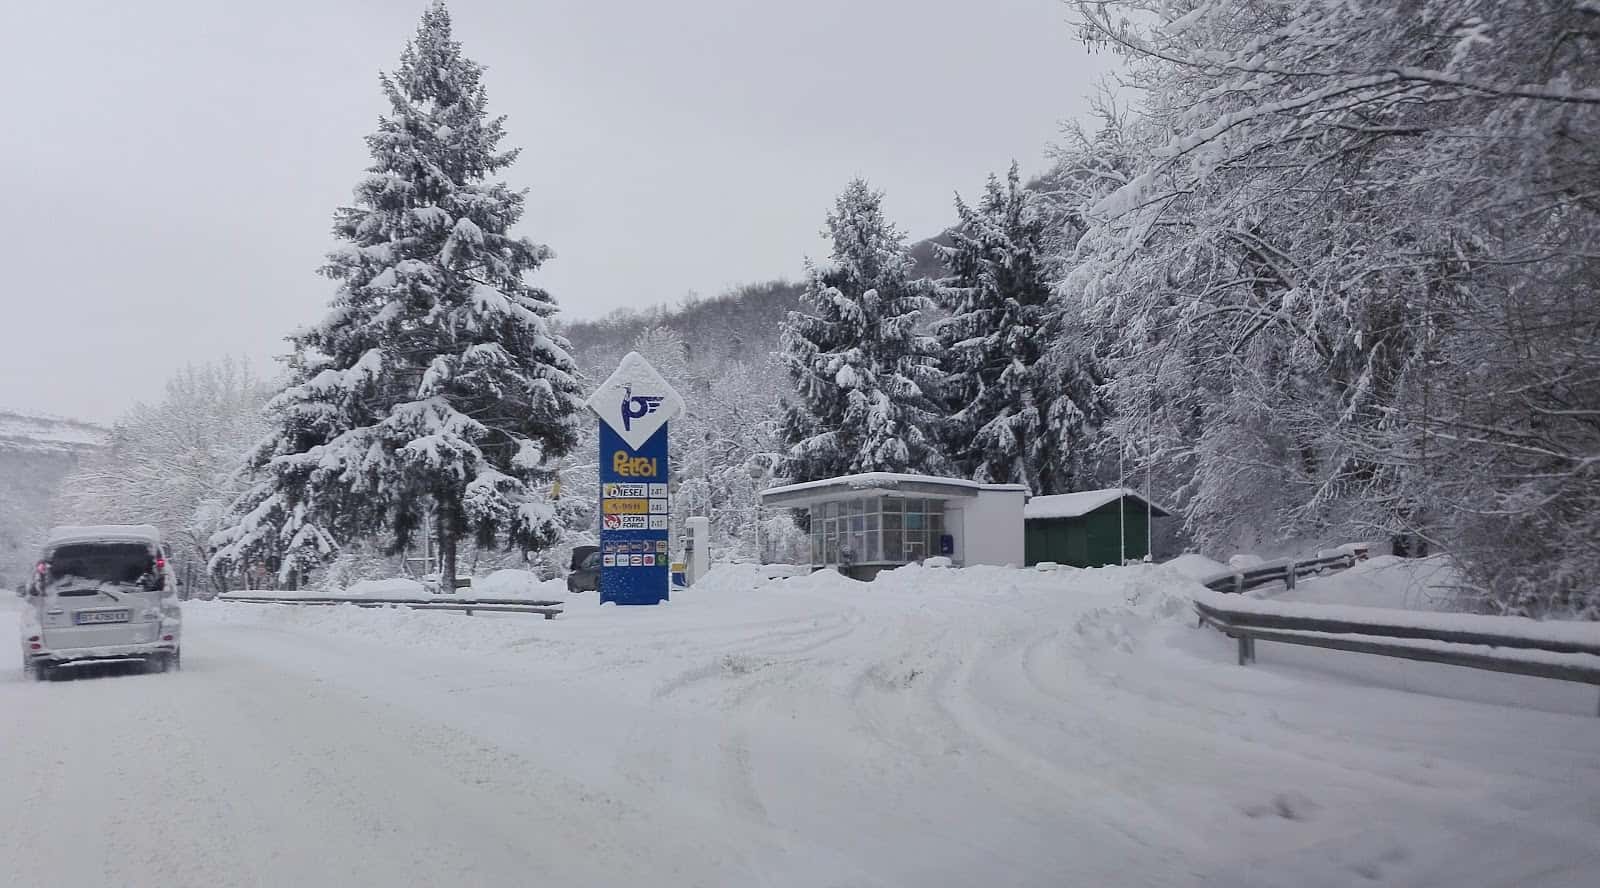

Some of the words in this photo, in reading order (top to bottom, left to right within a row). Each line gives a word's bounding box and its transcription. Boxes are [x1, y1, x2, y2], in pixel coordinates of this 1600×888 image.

[613, 450, 656, 477] Petrol
[609, 486, 644, 498] DIESEL
[607, 520, 620, 529] 96
